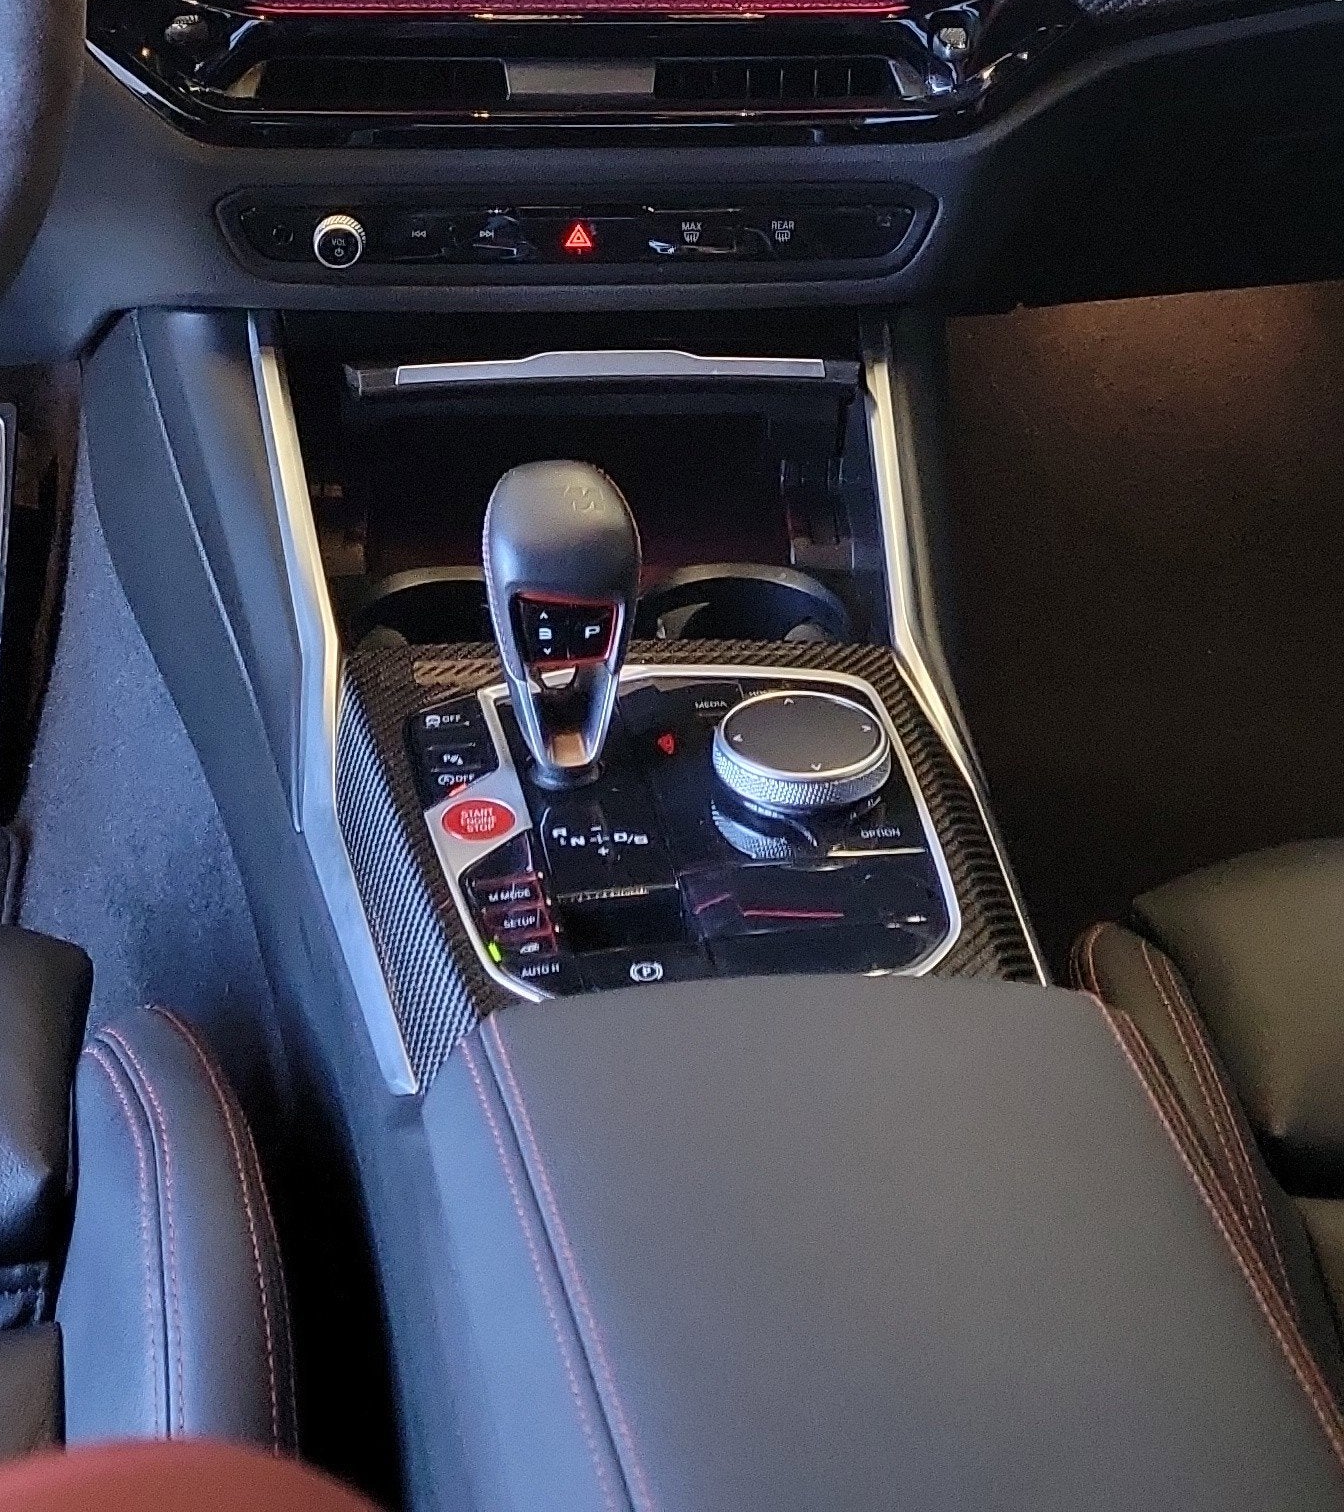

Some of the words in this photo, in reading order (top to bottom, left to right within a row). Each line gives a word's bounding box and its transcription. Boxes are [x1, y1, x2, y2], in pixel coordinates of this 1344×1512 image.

[681, 221, 702, 231] MAX
[771, 220, 795, 231] REAR
[331, 238, 346, 247] VOL
[584, 625, 601, 640] P
[442, 714, 462, 724] OFF
[860, 828, 902, 840] OPTION
